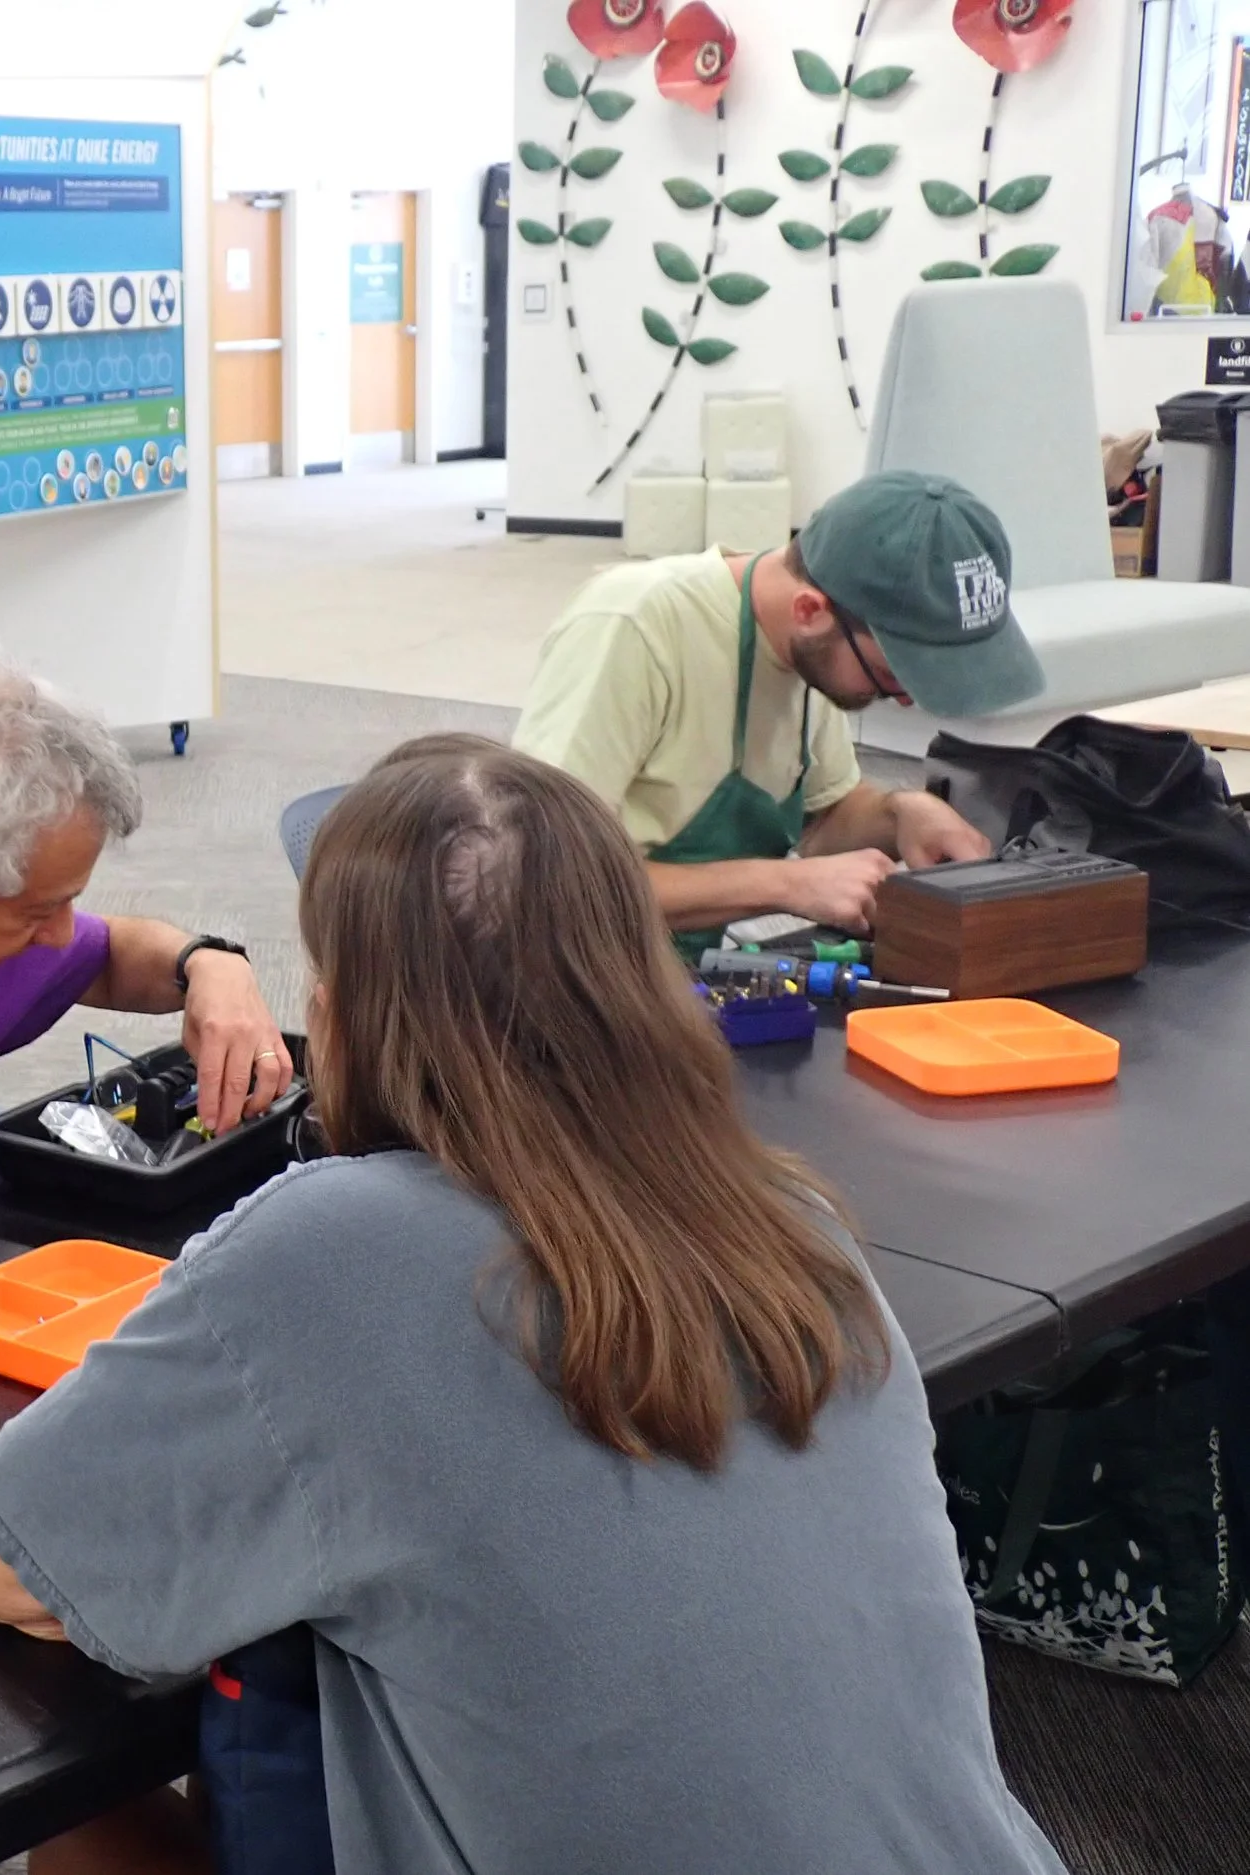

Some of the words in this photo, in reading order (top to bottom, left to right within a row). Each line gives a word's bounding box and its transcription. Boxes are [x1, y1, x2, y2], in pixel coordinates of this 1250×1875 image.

[58, 138, 75, 161] AT
[76, 137, 109, 163] DUKE
[111, 140, 159, 165] ENERGY
